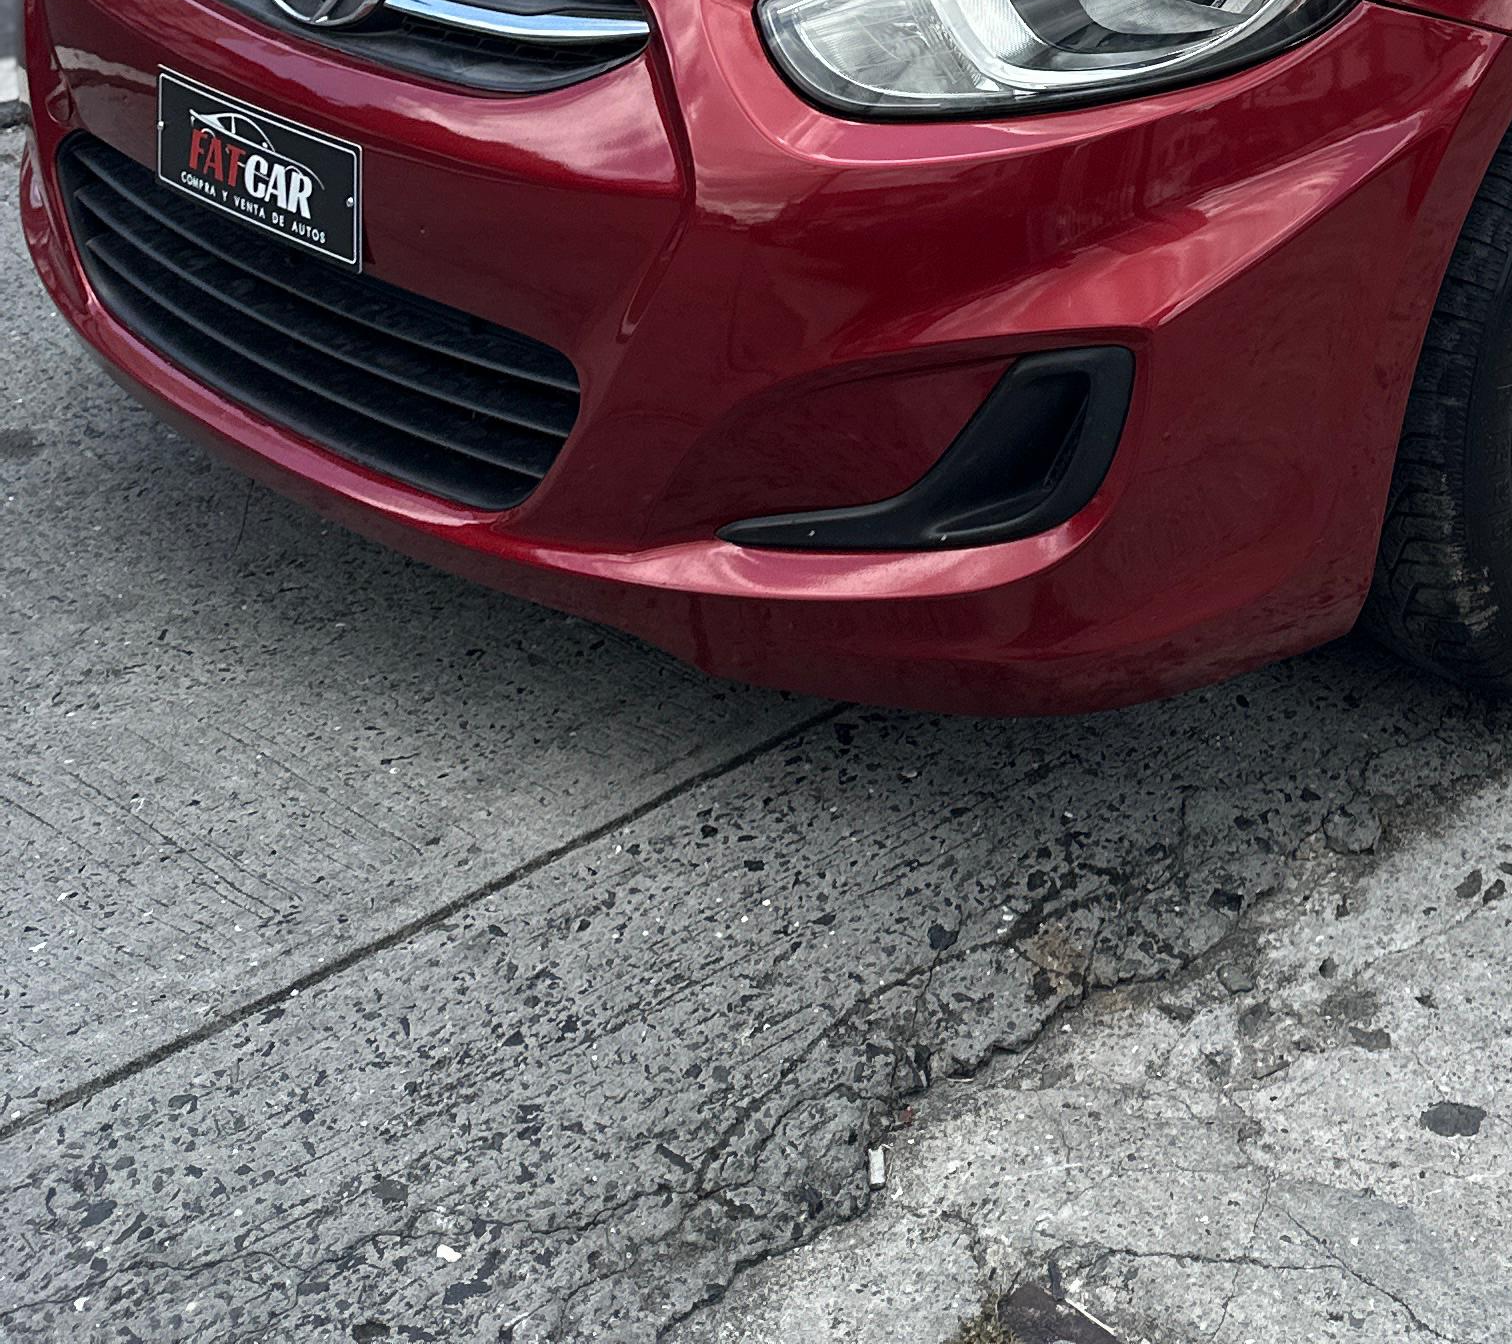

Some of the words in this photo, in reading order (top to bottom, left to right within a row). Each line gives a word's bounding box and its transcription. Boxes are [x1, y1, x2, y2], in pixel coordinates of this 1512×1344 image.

[181, 171, 216, 197] COMPRA
[222, 190, 229, 202] Y
[233, 195, 266, 219] VENTA
[272, 212, 285, 227] DE
[291, 221, 326, 244] AUTOS
